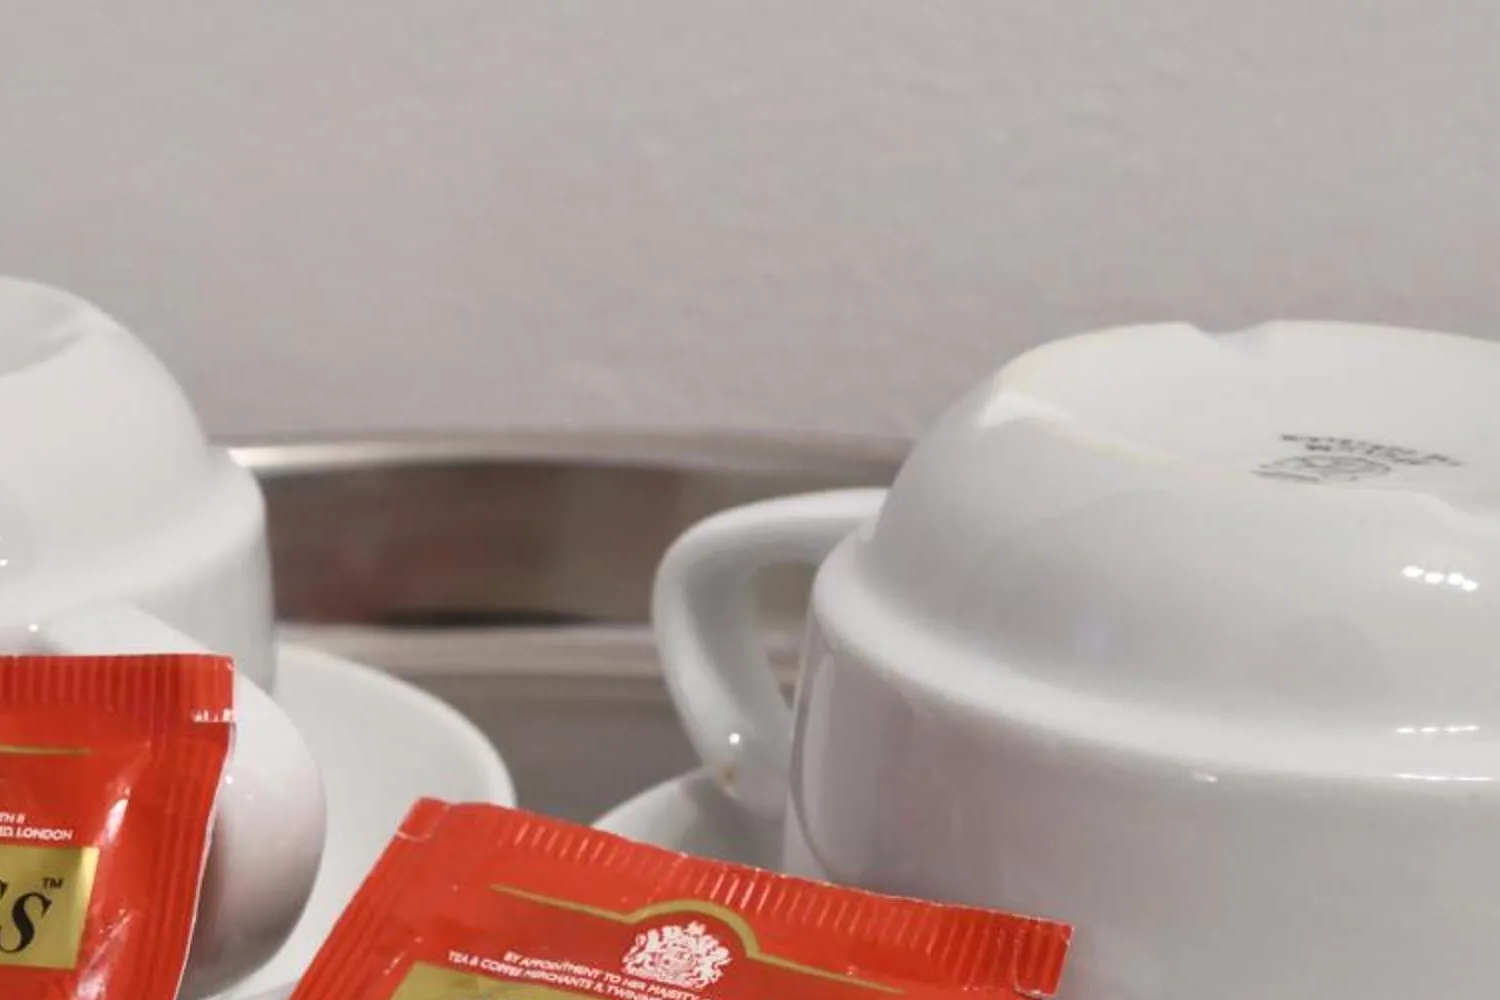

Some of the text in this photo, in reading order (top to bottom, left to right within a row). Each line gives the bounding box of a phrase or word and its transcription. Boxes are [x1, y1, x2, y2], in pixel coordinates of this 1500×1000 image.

[15, 827, 74, 841] LONDON
[448, 950, 469, 965] TEA
[603, 972, 621, 983] TO
[622, 977, 646, 989] HER
